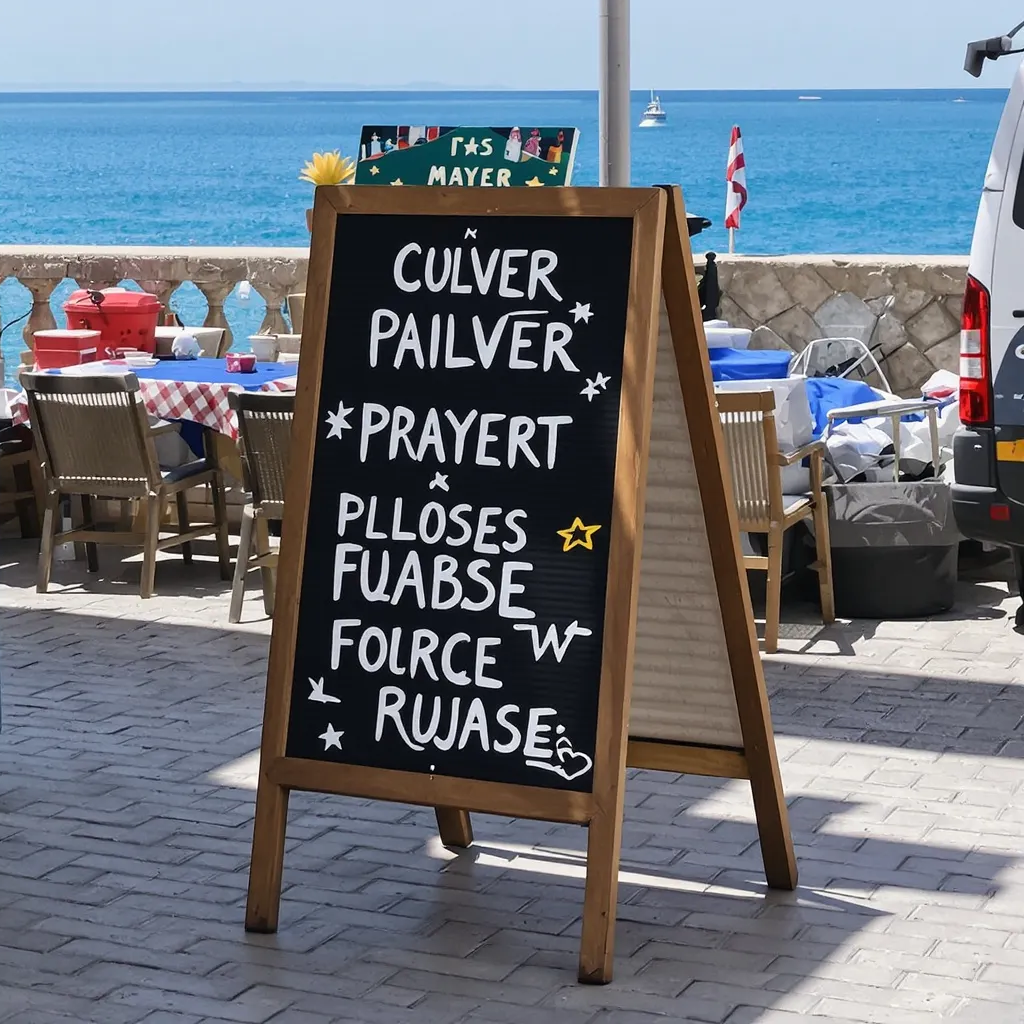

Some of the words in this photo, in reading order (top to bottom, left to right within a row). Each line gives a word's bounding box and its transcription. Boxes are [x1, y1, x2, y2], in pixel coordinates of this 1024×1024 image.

[427, 165, 512, 188] MAYER
[393, 242, 564, 303] CULVER
[370, 308, 581, 373] PAILVER
[360, 402, 574, 470] PRAYERT
[337, 492, 528, 555] PLLOSES
[332, 543, 537, 619] FUABSE
